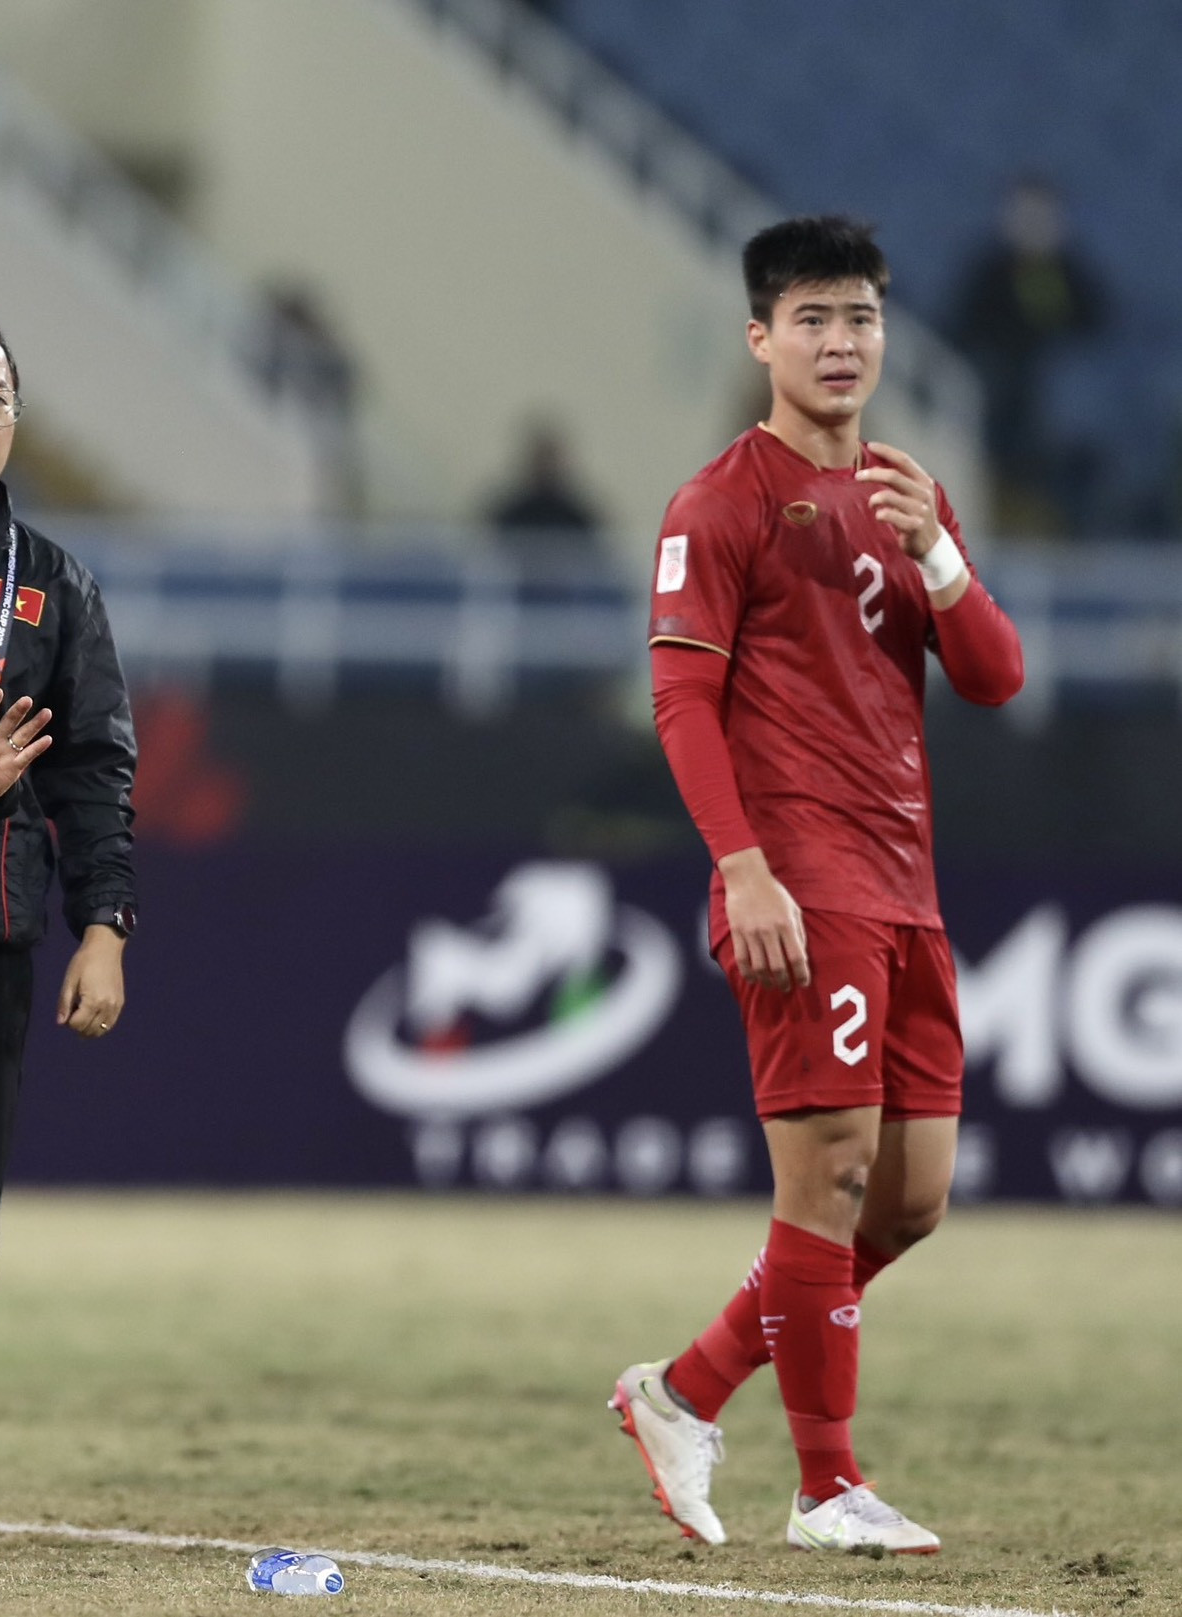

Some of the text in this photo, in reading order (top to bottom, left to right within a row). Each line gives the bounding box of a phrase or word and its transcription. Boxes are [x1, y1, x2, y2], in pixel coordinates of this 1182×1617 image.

[0, 608, 11, 627] CUP
[2, 573, 15, 609] ELECTRIC
[852, 552, 885, 634] 2
[830, 985, 869, 1068] 2
